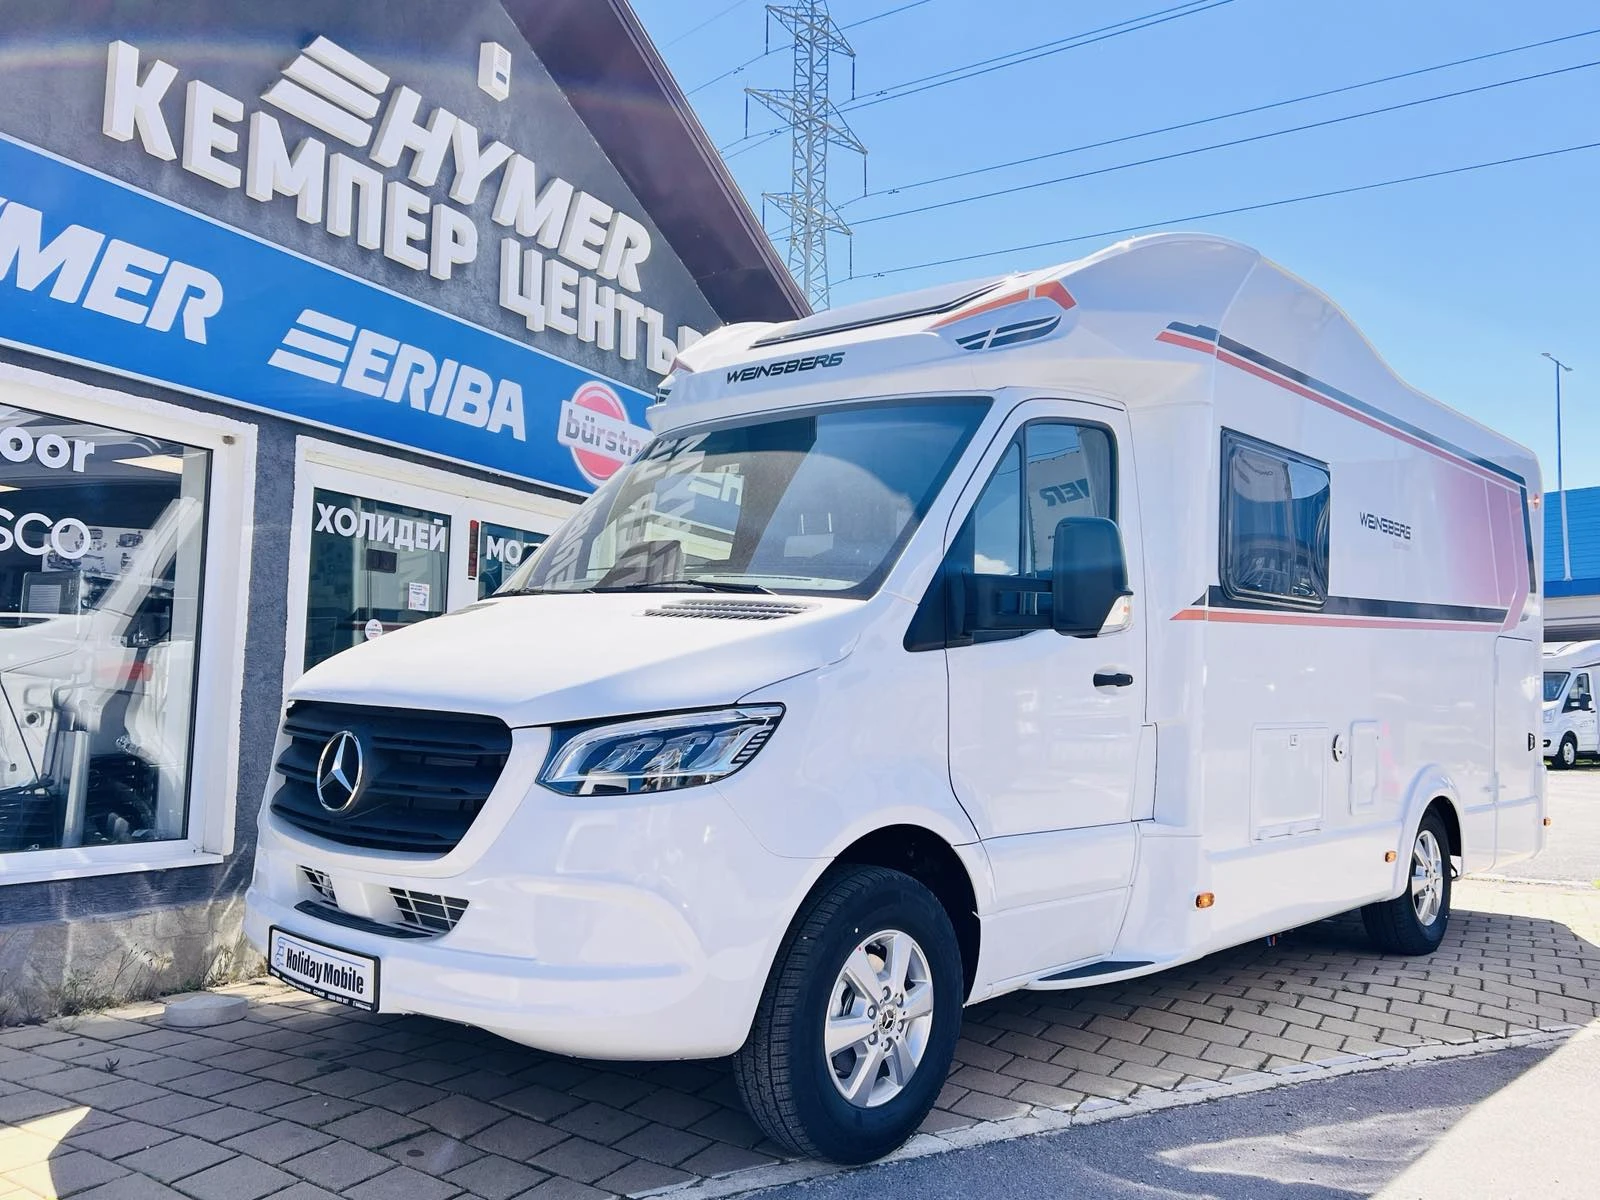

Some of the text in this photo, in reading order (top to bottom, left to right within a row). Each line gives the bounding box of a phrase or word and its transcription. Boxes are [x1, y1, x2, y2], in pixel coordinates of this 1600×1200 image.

[103, 39, 478, 280] КЕМПЕР
[369, 85, 651, 292] HYMER
[0, 197, 223, 344] MER
[342, 329, 526, 441] ERIBA
[727, 352, 845, 384] WEINSBERG
[315, 502, 446, 552] ХОЛИДЕЙ
[1359, 511, 1411, 540] WEINSBERG
[286, 947, 322, 983] Holiday
[323, 962, 364, 994] Mobile
